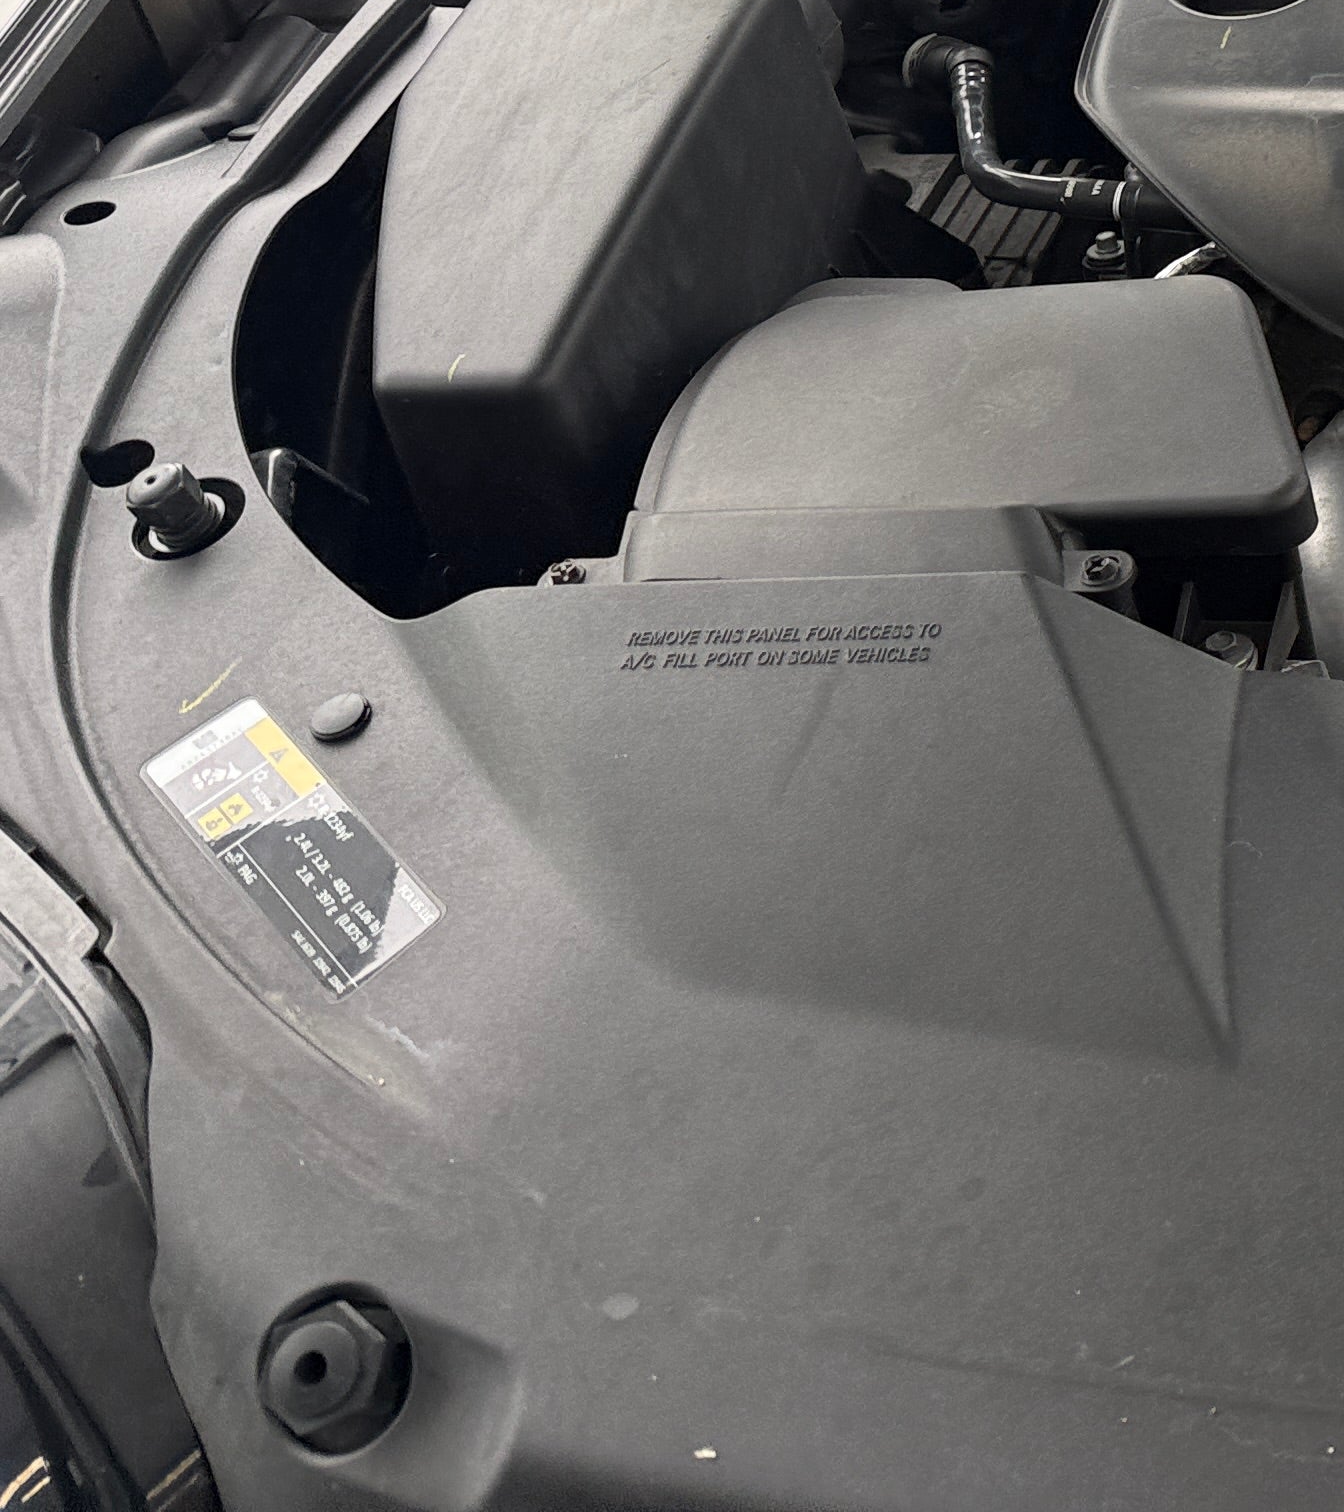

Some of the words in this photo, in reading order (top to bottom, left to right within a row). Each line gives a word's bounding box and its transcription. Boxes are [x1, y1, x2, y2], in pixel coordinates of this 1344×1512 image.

[625, 629, 702, 647] REMOVE
[703, 627, 744, 645] THIS
[745, 626, 801, 643] PANEL
[805, 625, 843, 641] FOR
[843, 624, 915, 641] ACCESS
[919, 623, 943, 639] TO
[620, 652, 656, 671] A/C
[662, 651, 698, 668] FILL
[704, 650, 753, 667] PORT
[757, 649, 785, 666] ON
[788, 649, 840, 665] SOME
[847, 646, 932, 664] VEHICLES
